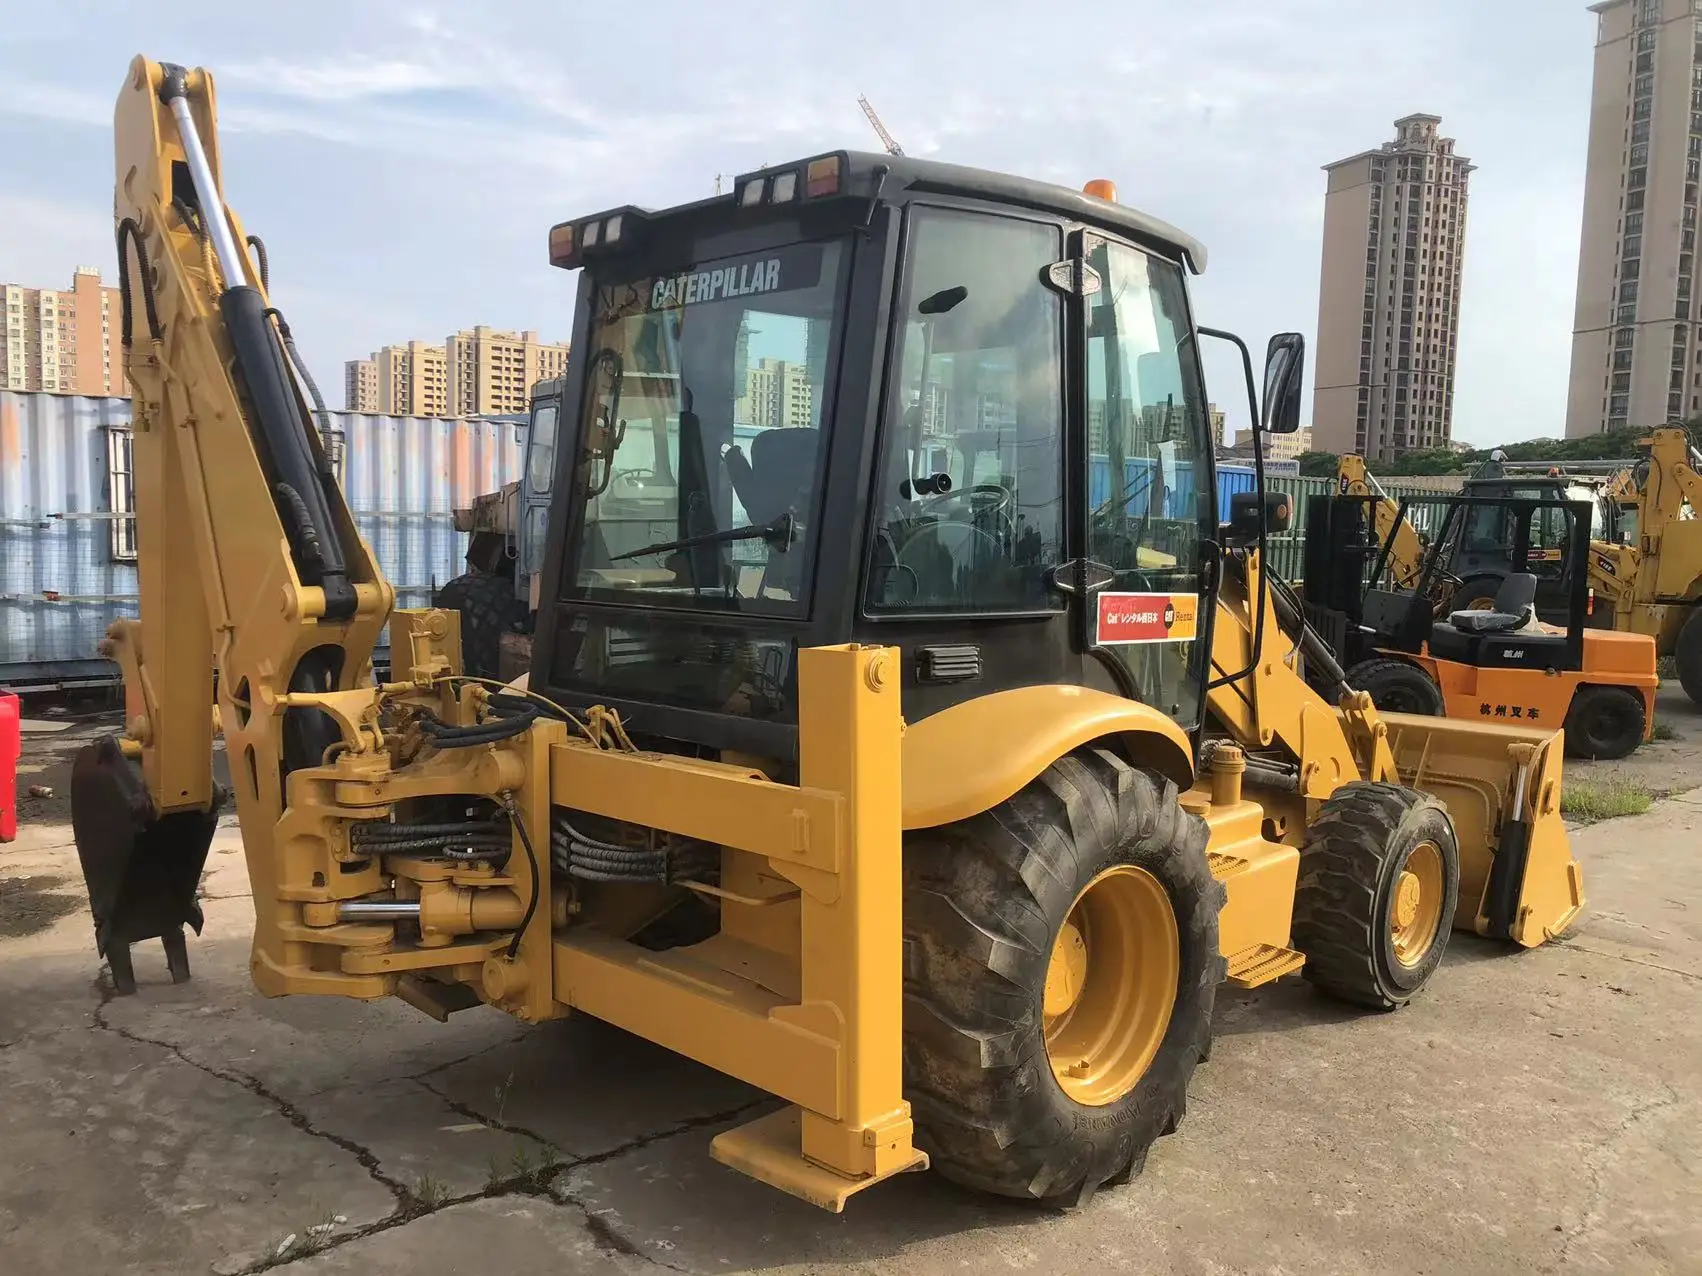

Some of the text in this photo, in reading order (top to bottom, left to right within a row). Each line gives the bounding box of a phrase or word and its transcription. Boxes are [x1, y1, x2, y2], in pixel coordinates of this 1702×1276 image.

[651, 258, 780, 309] CATERPILLAR
[1480, 702, 1540, 719] 杭州叉车
